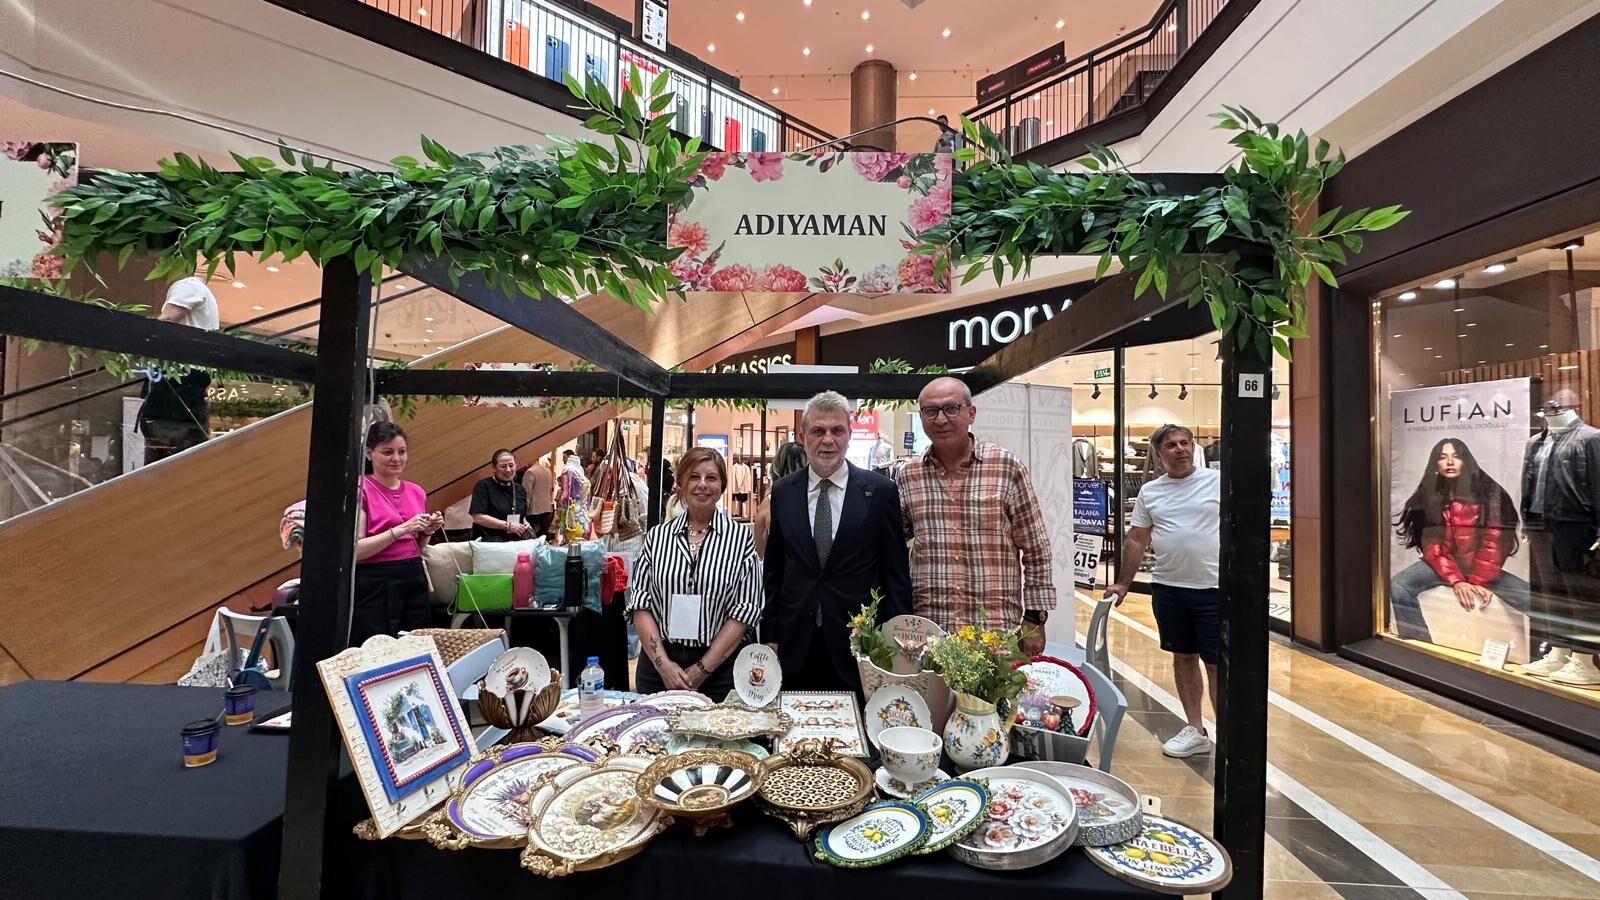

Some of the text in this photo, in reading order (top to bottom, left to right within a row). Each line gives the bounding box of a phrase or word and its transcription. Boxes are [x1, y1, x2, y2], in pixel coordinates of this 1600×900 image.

[734, 214, 887, 236] ADIYAMAN
[1245, 380, 1258, 391] 66
[1404, 400, 1511, 424] LUFIAN
[1078, 509, 1100, 517] ALANA
[1159, 845, 1202, 860] BELLA
[1117, 854, 1139, 866] CON
